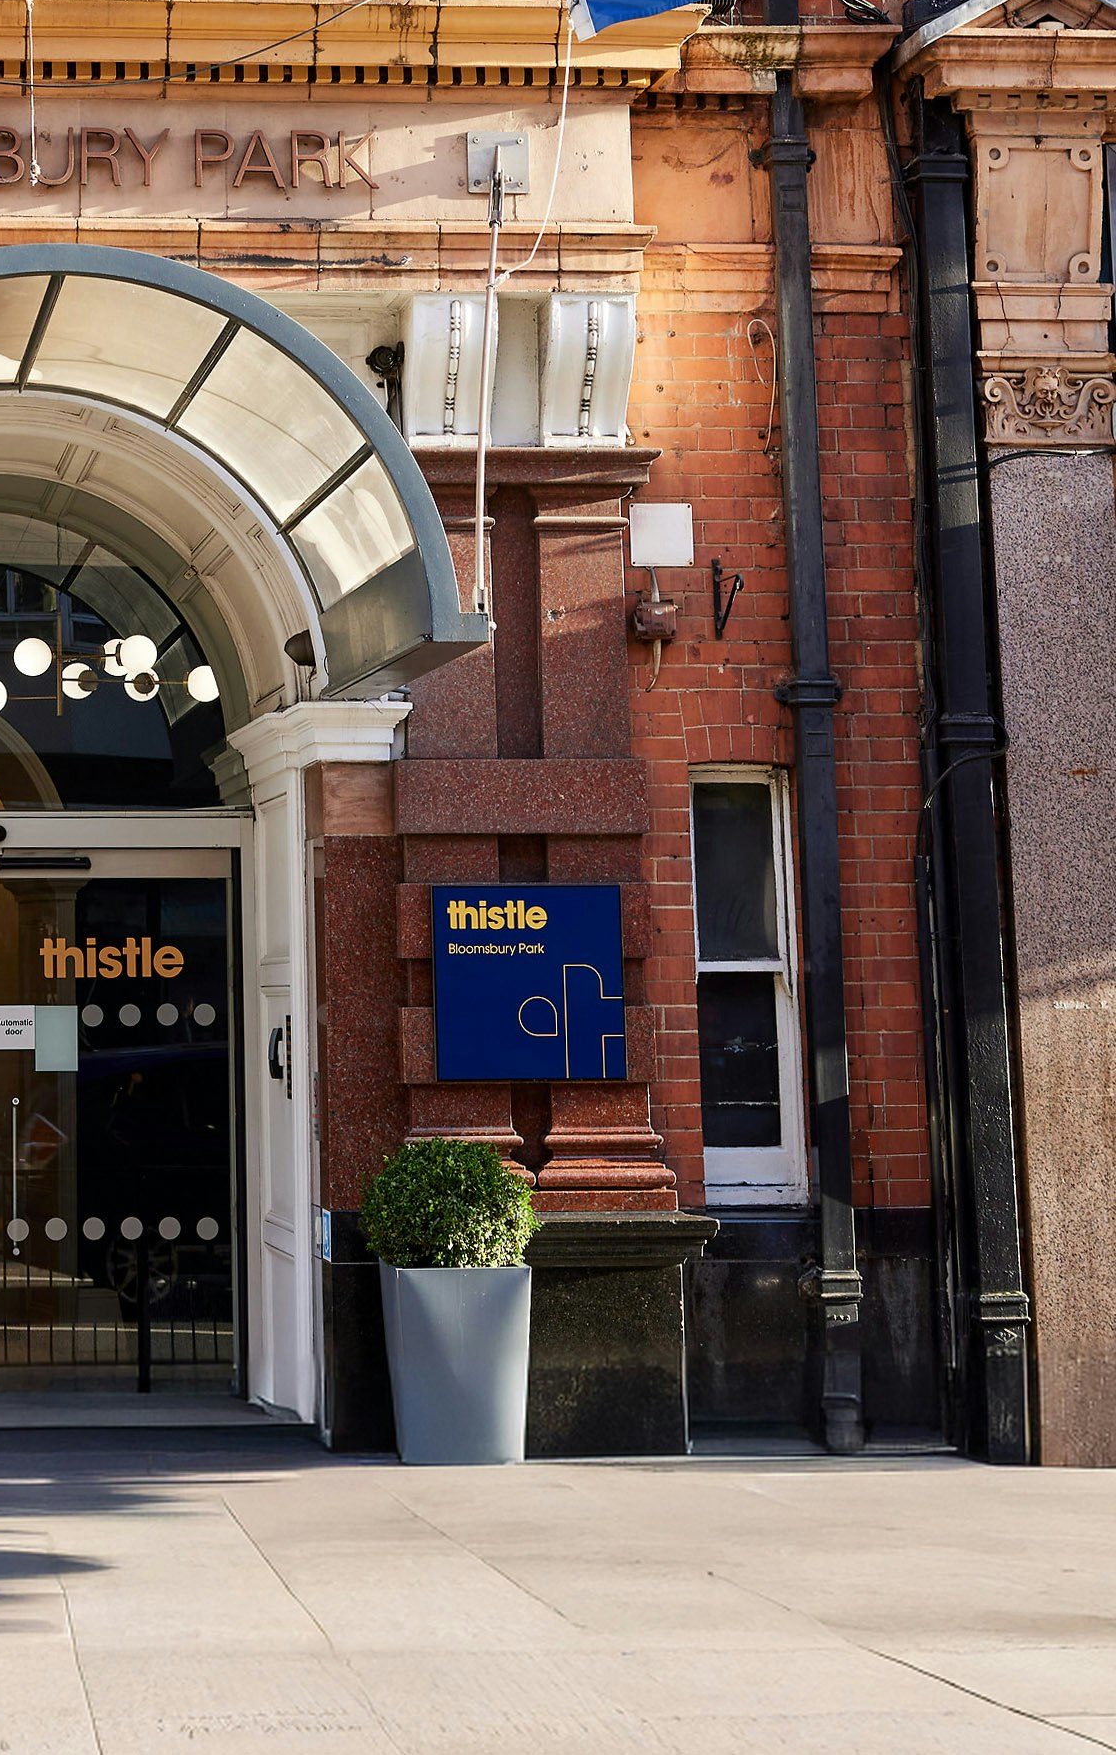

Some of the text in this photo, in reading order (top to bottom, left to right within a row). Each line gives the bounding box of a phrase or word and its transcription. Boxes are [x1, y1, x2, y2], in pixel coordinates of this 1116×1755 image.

[195, 129, 379, 189] PARK
[447, 900, 548, 930] thistle
[39, 937, 185, 979] thistle
[448, 943, 545, 956] Bloomsbury Park
